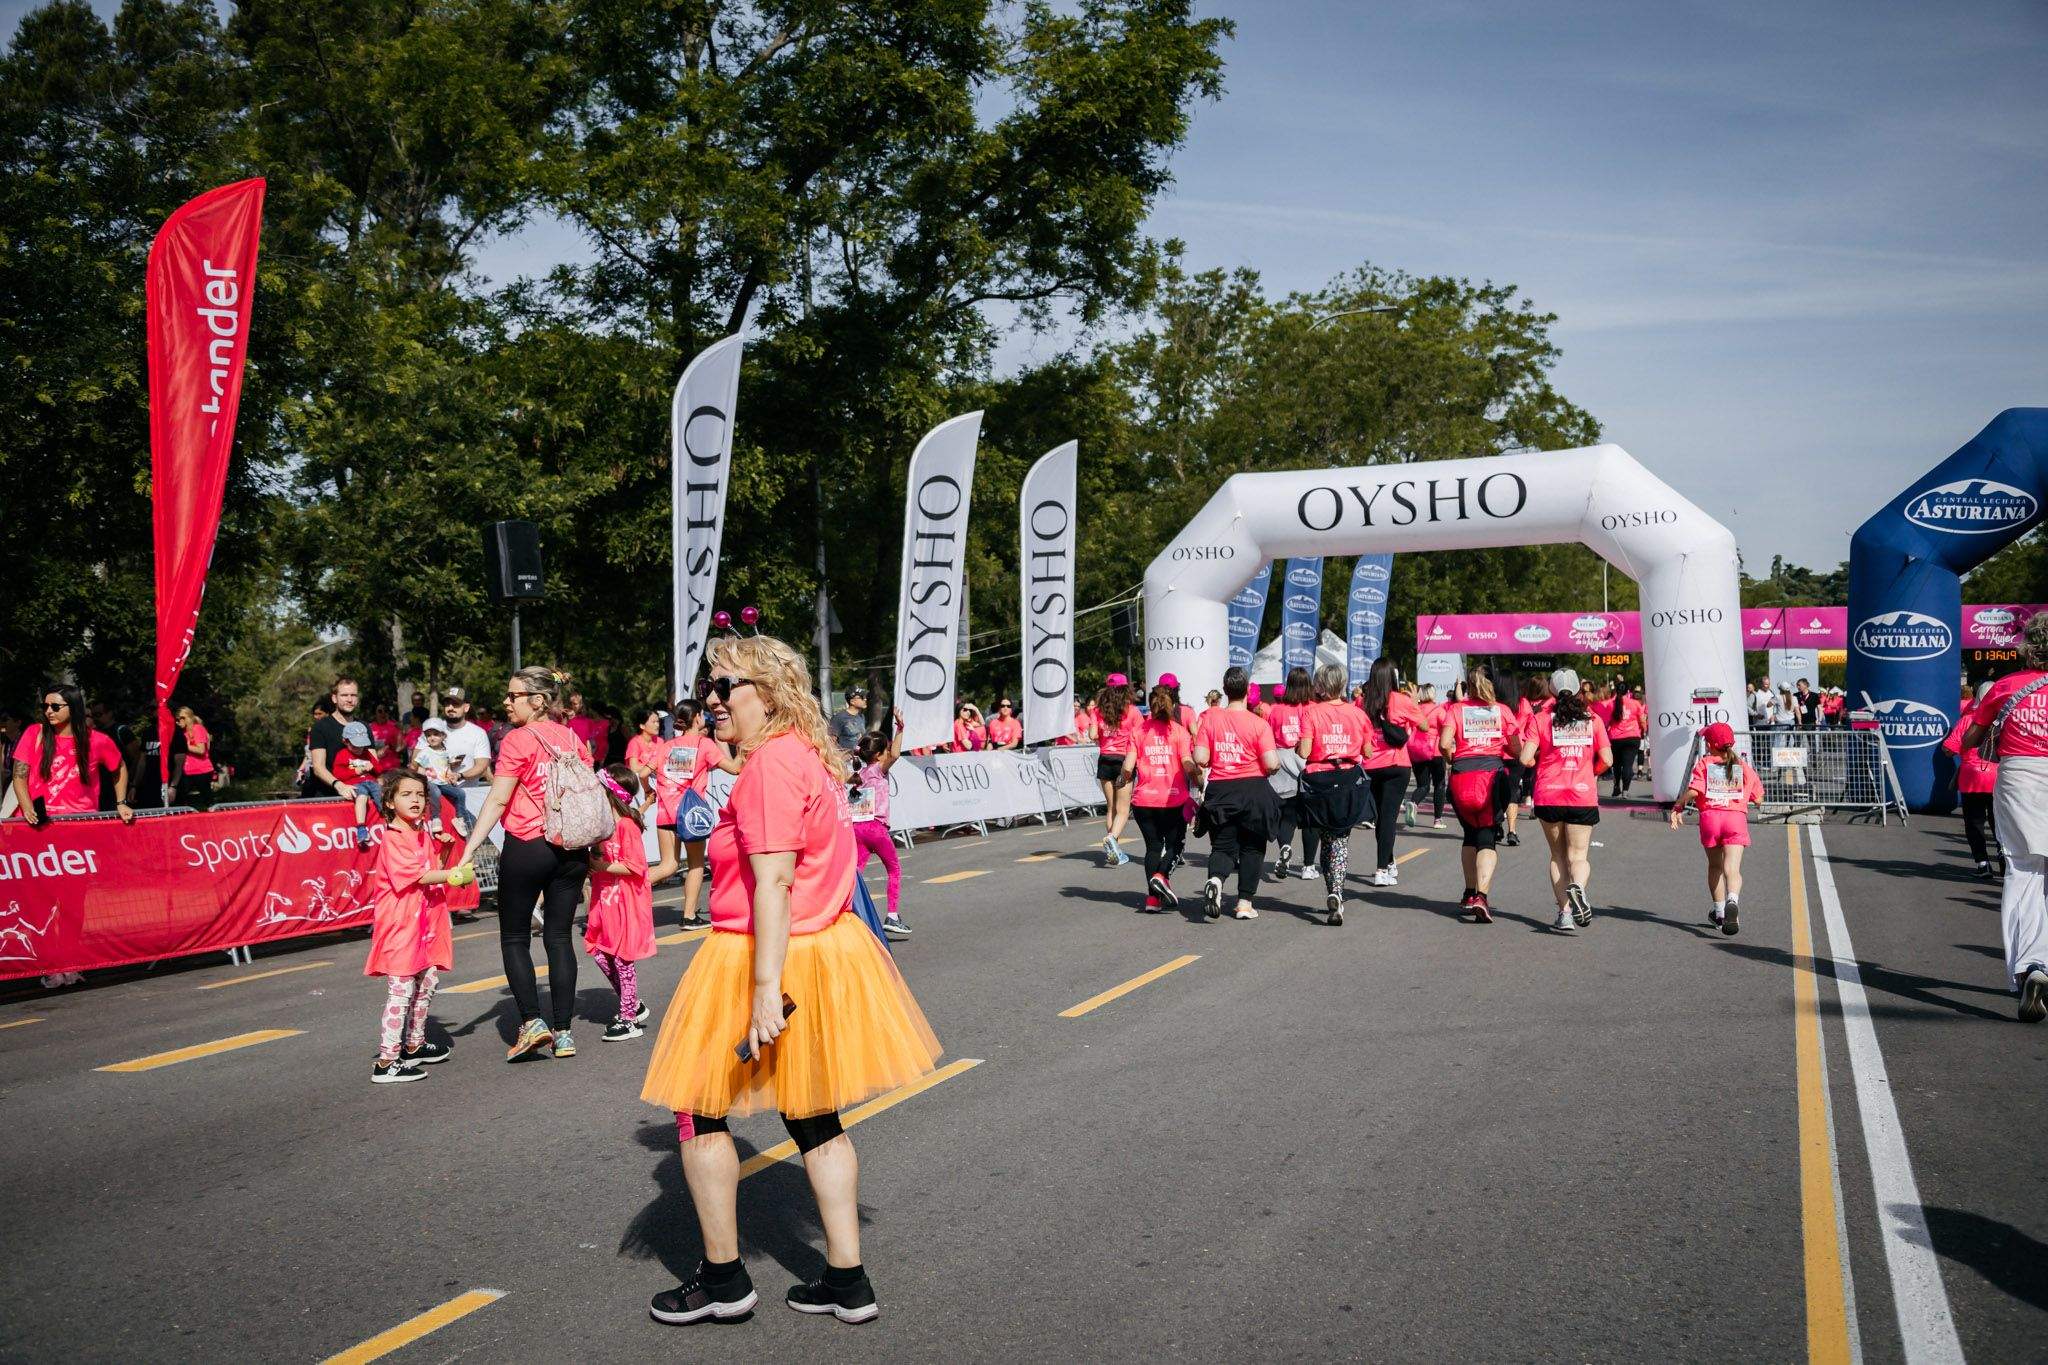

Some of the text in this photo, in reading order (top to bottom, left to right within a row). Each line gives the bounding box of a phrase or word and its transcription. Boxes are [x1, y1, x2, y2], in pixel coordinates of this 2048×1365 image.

[1299, 472, 1527, 531] OYSHO
[1935, 496, 2026, 505] CENTRAL LECHERA
[1913, 499, 2026, 520] ASTURIANA
[1602, 510, 1677, 531] OYSHO
[1172, 545, 1234, 561] OYSHO
[905, 475, 961, 701] OYSHO
[1030, 500, 1068, 699] OYSHO
[1651, 608, 1723, 628] OYSHO
[1468, 631, 1498, 640] OYSHO
[1800, 627, 1831, 635] Santander
[1970, 623, 2004, 633] Carrera
[1148, 636, 1204, 652] OYSHO
[1858, 629, 1947, 648] ASTURIANA
[1990, 631, 2016, 646] Mujer
[1522, 660, 1551, 668] OYSHO
[2029, 694, 2047, 707] TU
[1658, 709, 1730, 728] OYSHO
[2012, 708, 2048, 722] DORS
[924, 763, 990, 794] OYSHO
[181, 830, 274, 873] Sports
